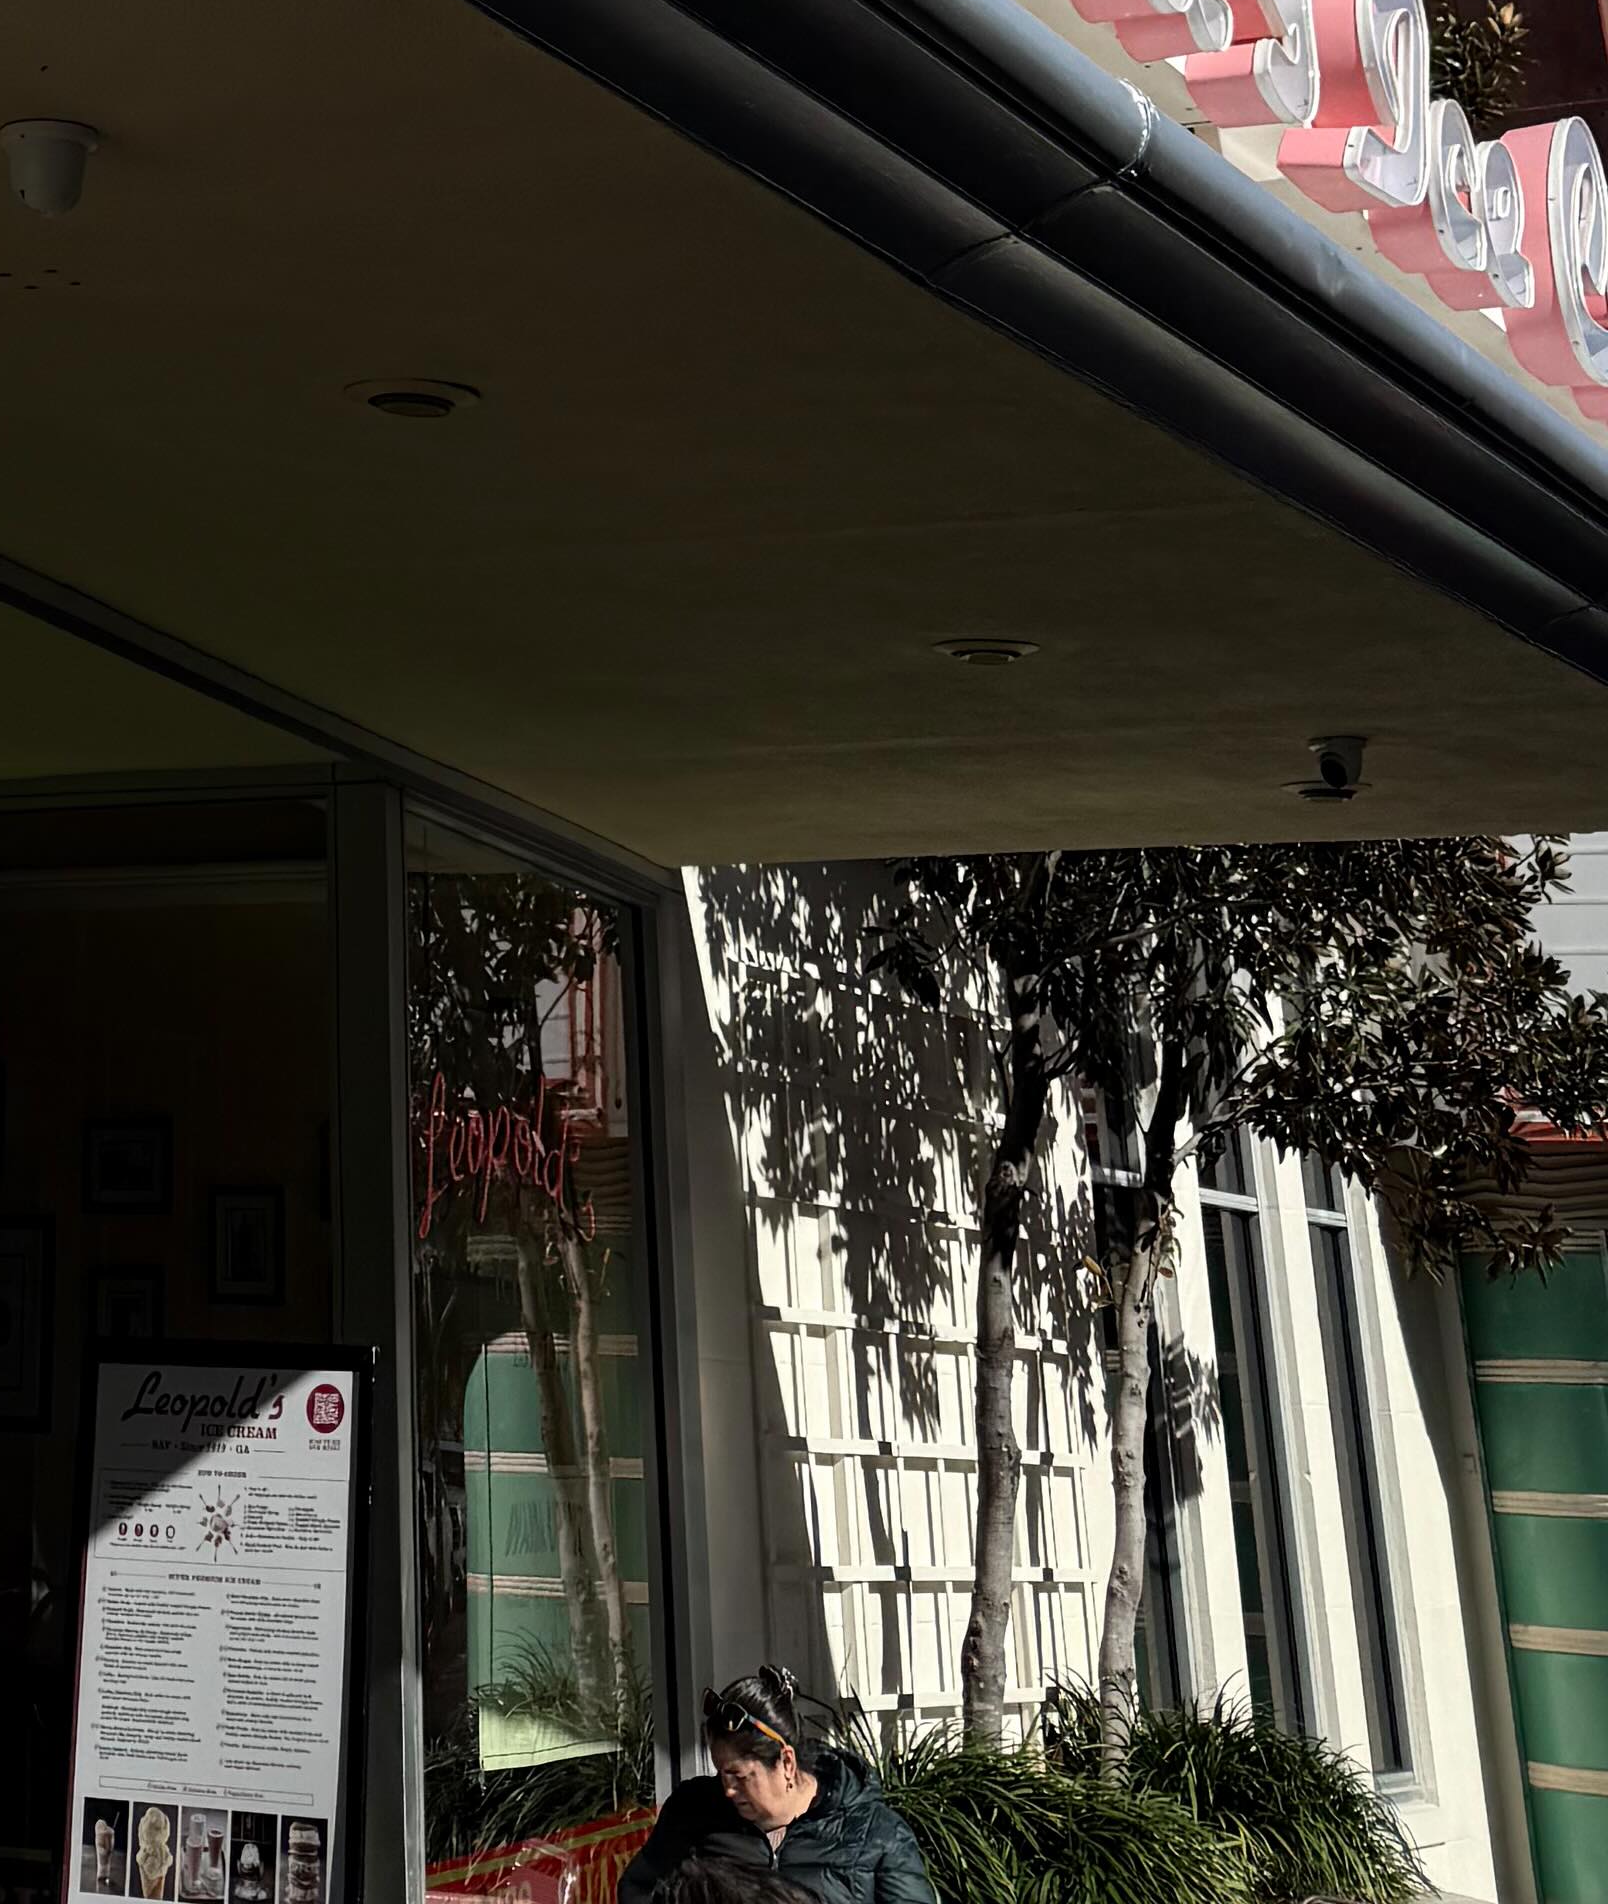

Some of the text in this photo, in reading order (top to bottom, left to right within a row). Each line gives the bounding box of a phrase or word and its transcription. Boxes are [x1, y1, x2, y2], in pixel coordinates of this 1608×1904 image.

[122, 1371, 286, 1433] Leopold's
[200, 1423, 278, 1440] ICE CREAM
